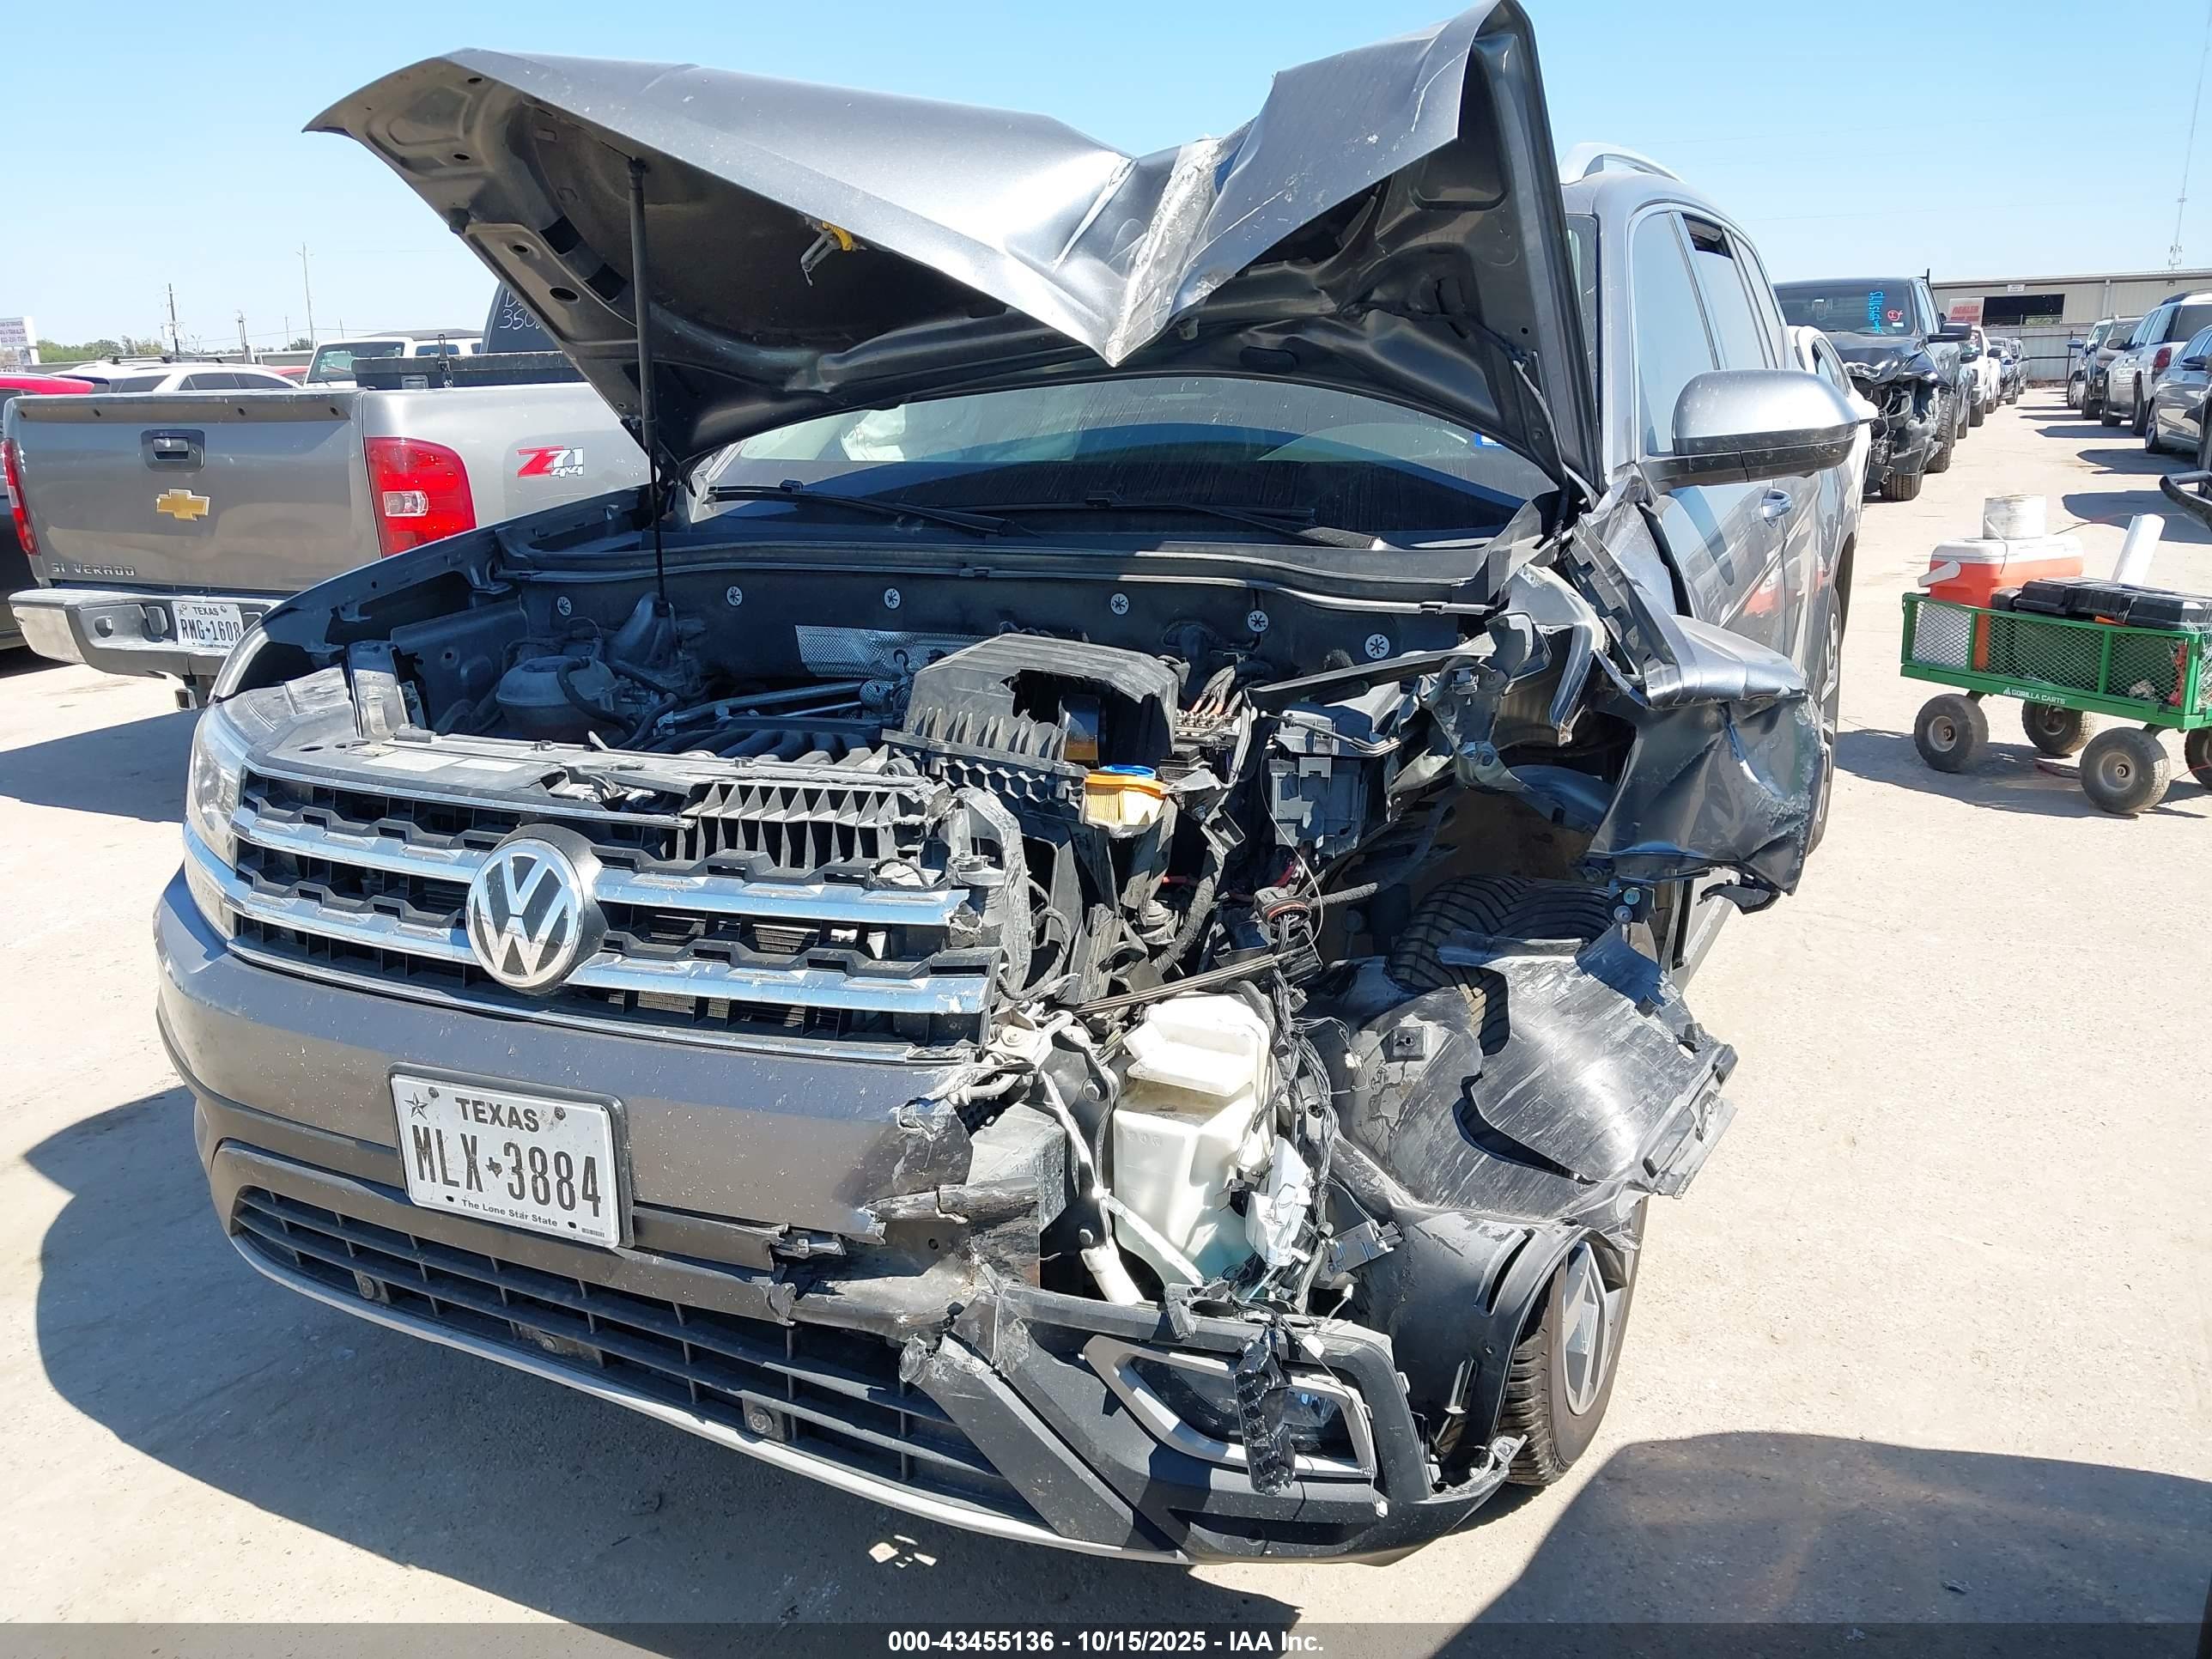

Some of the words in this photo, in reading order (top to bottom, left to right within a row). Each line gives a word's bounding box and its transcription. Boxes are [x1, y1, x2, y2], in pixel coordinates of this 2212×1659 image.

[192, 605, 219, 617] TEXAS
[2011, 689, 2040, 700] GORILLA
[455, 1096, 540, 1133] TEXAS
[461, 1198, 480, 1210] The
[483, 1203, 506, 1216] Lone
[508, 1208, 529, 1221] Star
[531, 1213, 558, 1227] State
